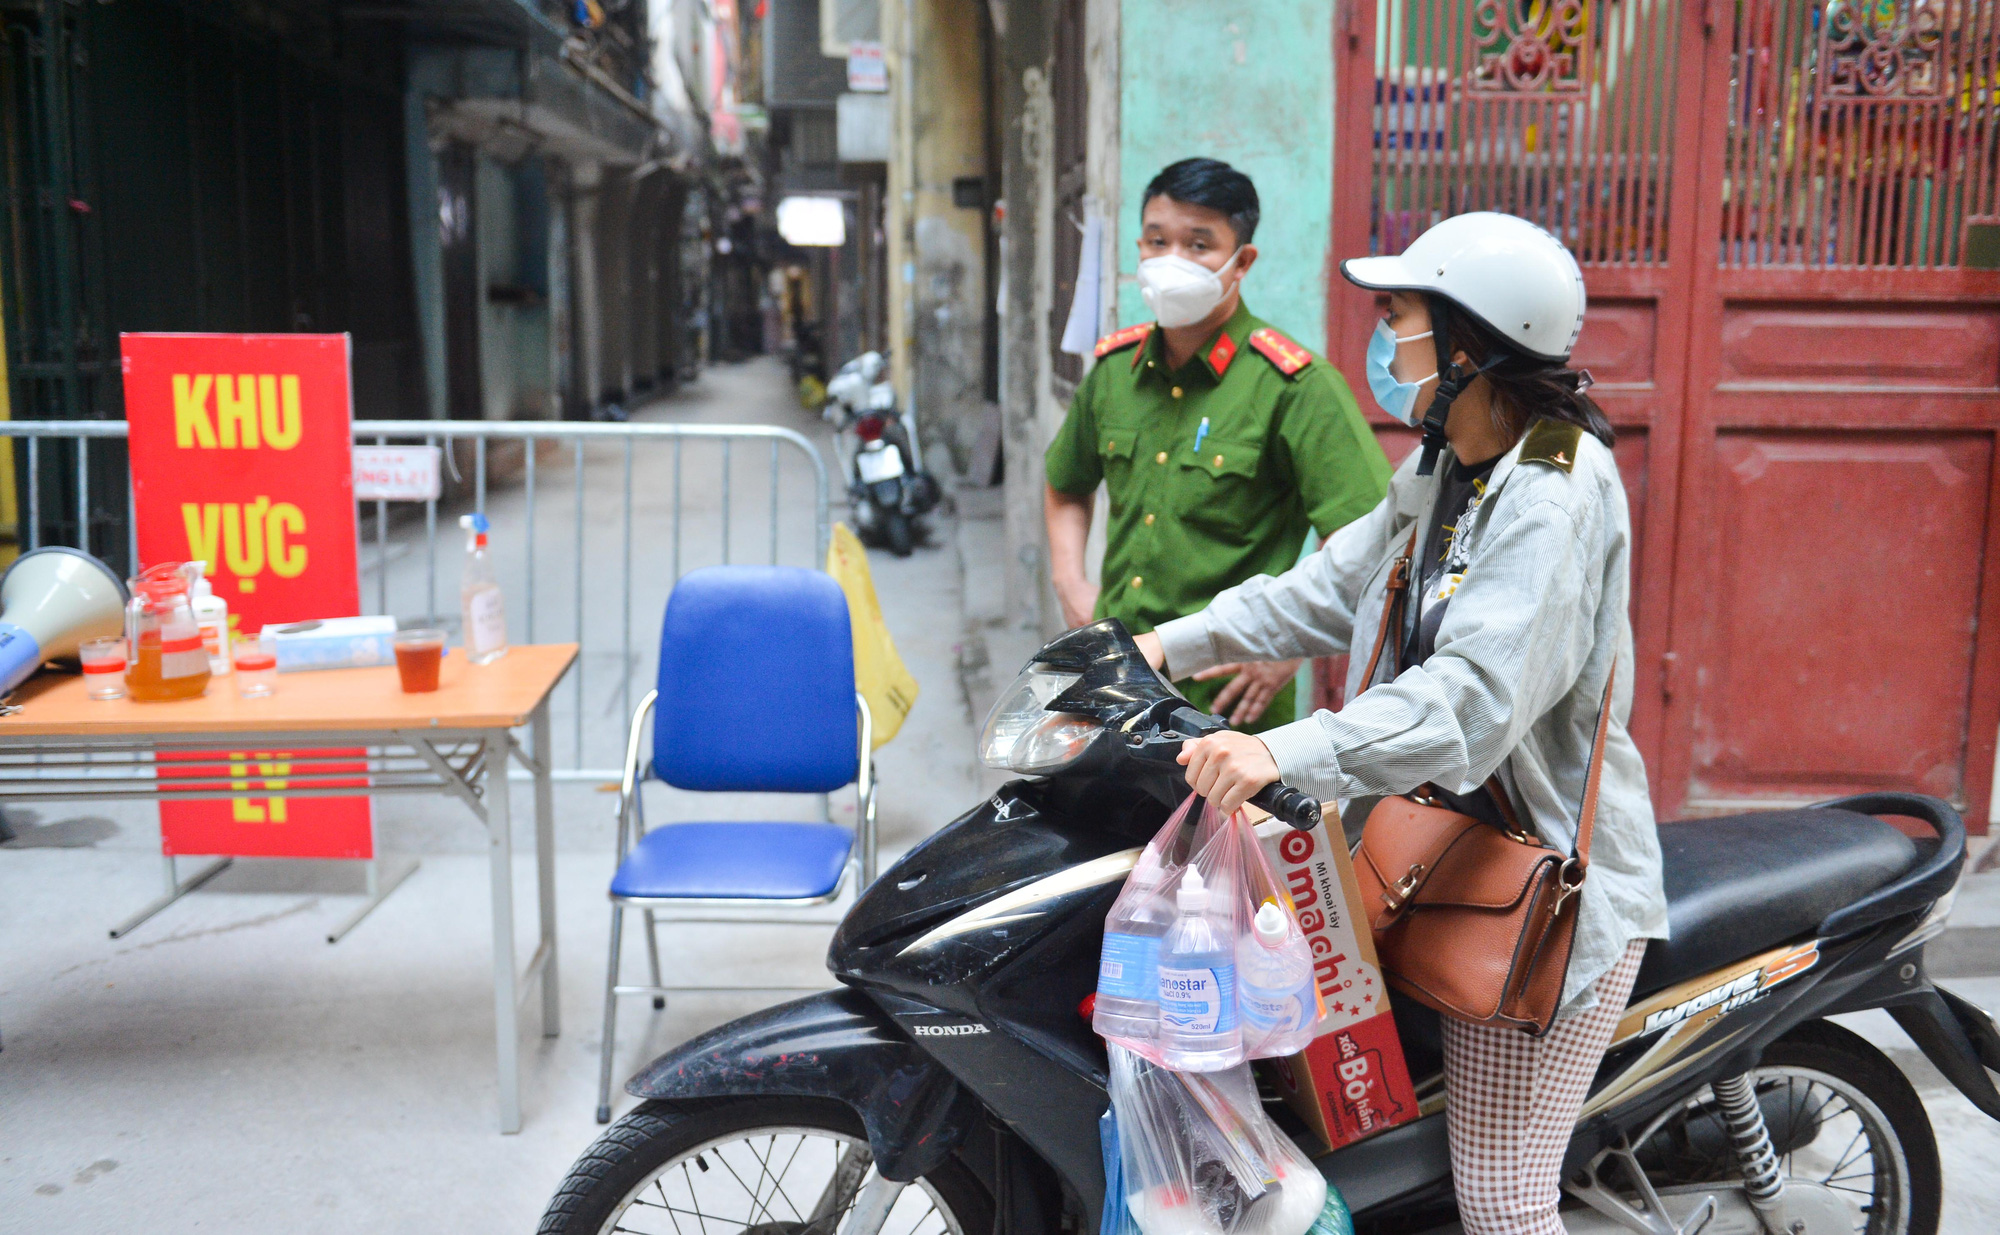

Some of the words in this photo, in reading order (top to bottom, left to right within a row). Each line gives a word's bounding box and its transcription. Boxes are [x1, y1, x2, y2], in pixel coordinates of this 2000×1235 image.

[172, 373, 302, 450] KHU
[181, 496, 308, 593] VỰC
[1315, 861, 1328, 877] Mì
[1320, 877, 1337, 909] khoai
[1329, 910, 1340, 929] tây
[1176, 990, 1191, 999] 0.9%
[914, 1023, 990, 1036] HONDA
[1338, 1033, 1358, 1059] xốt
[1339, 1056, 1373, 1100] Bò
[1356, 1098, 1376, 1130] hầm
